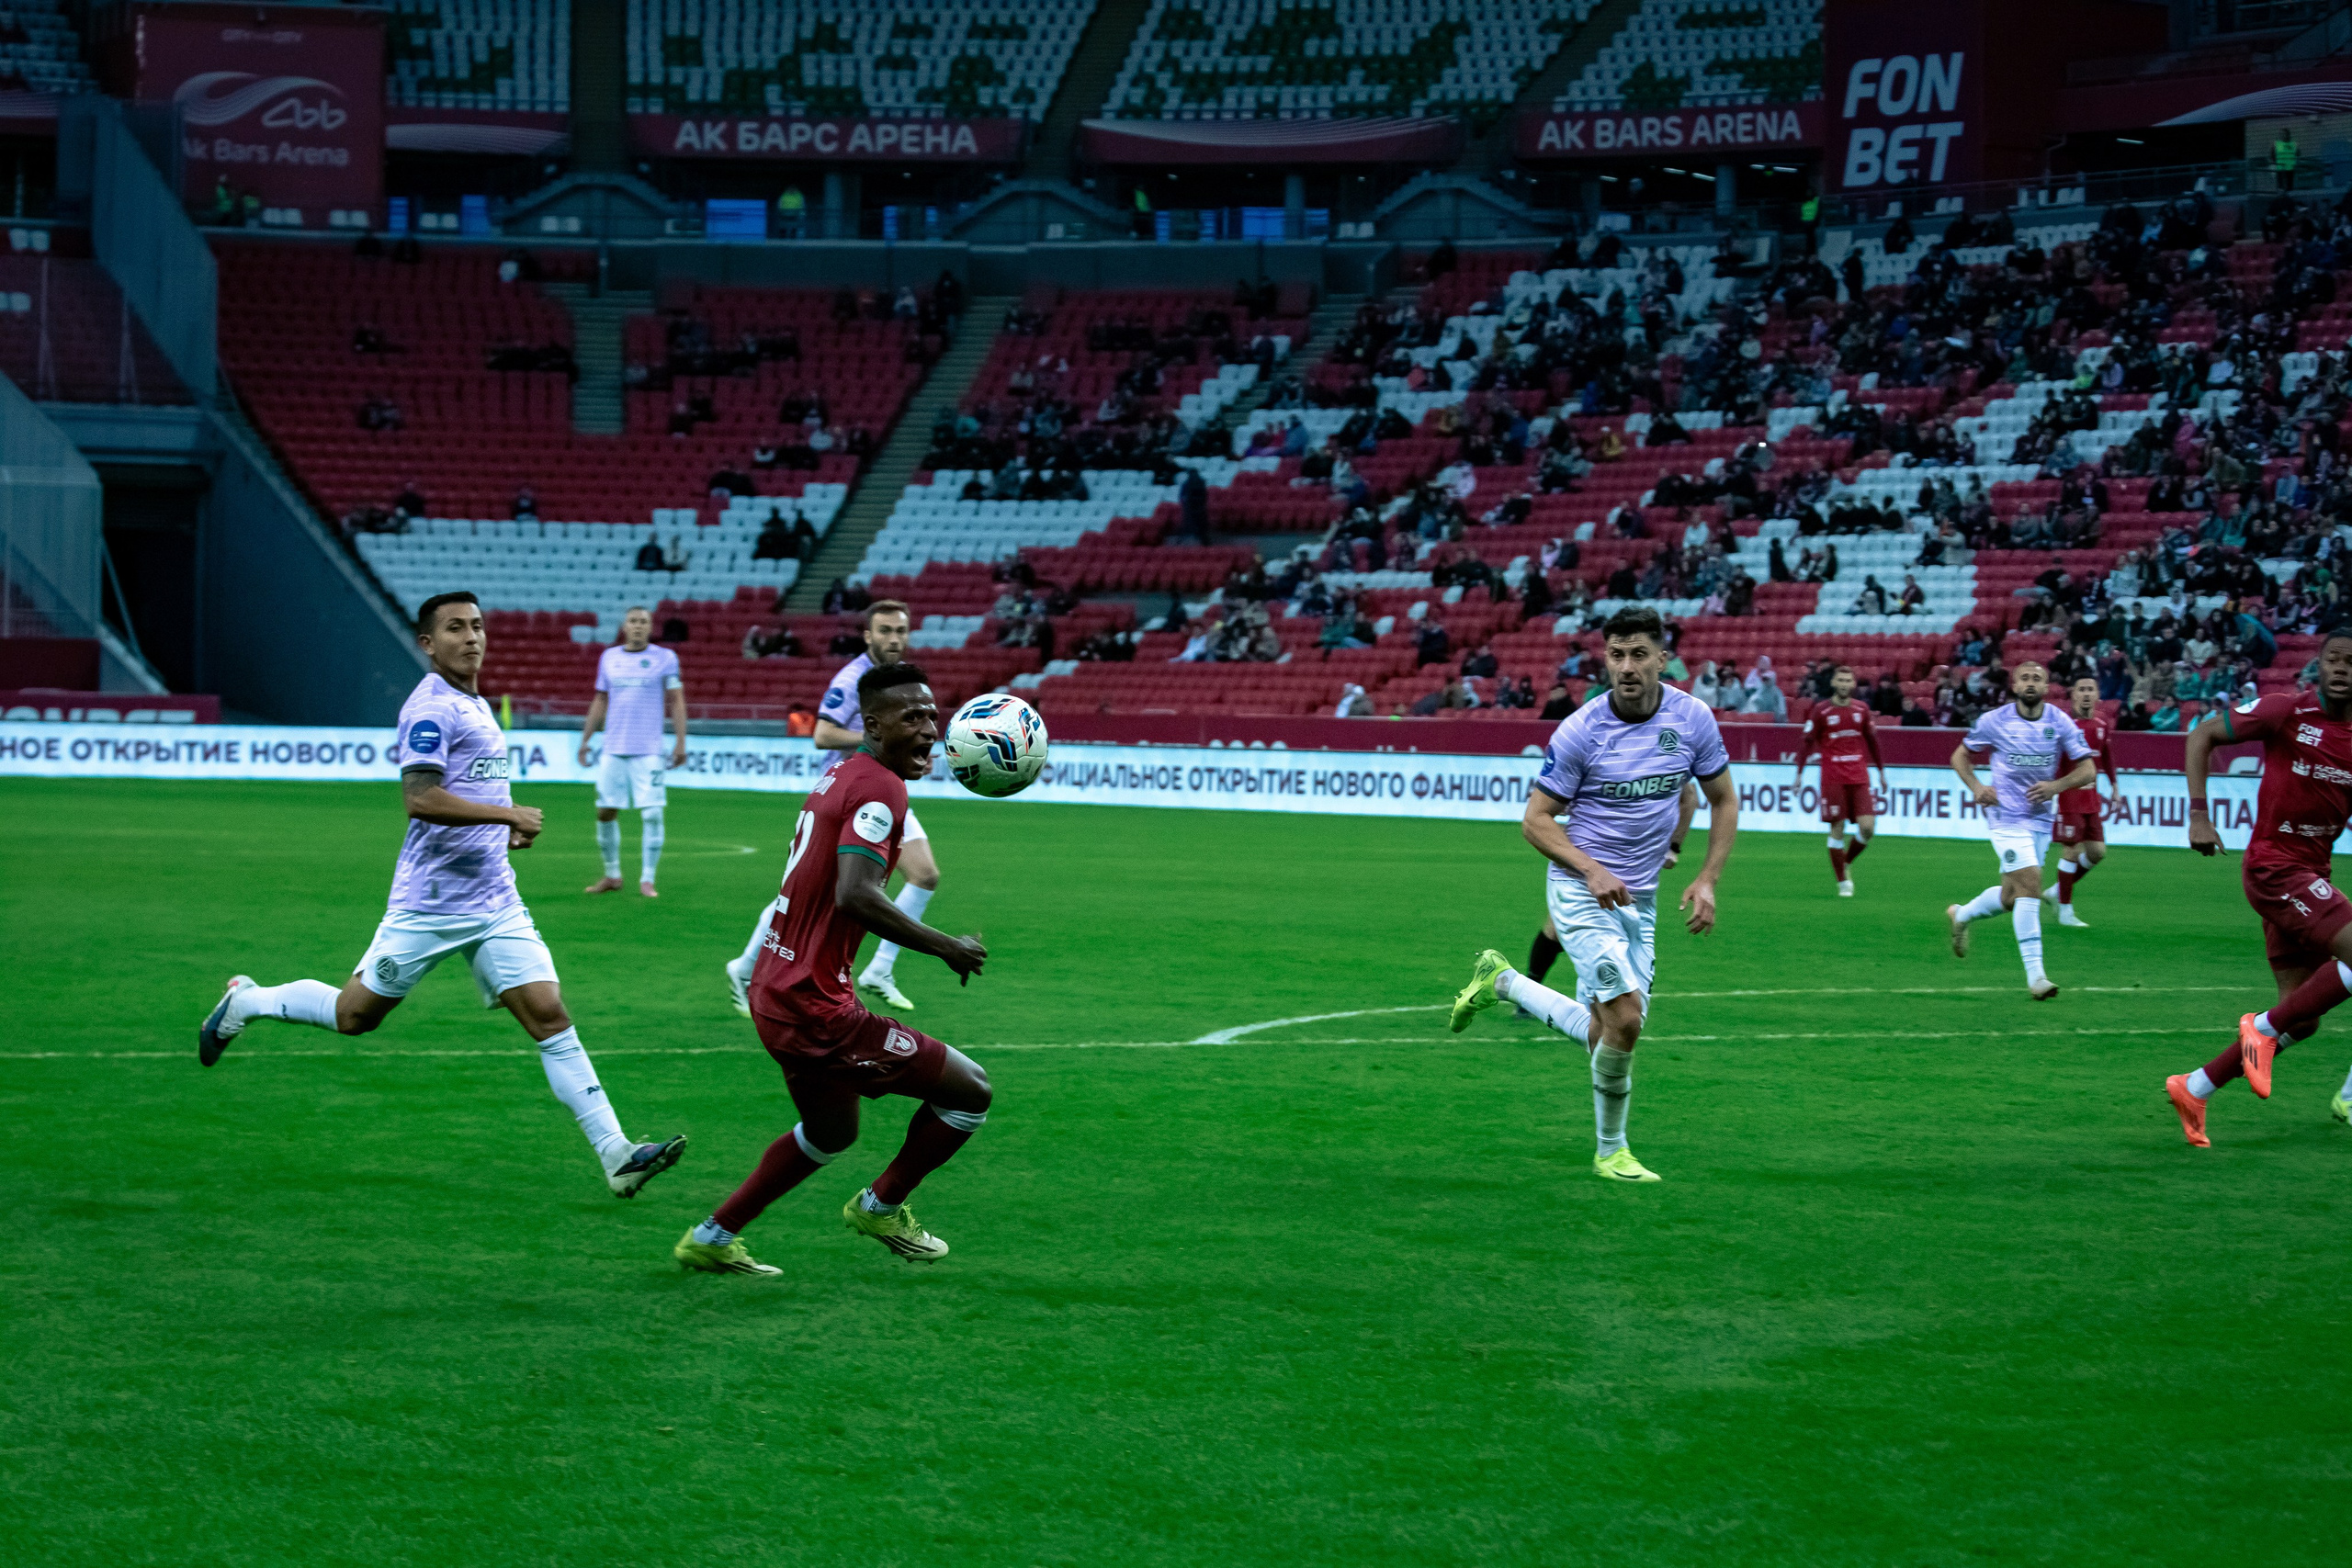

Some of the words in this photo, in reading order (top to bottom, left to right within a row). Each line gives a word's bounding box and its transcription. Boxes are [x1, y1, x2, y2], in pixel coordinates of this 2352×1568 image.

[1841, 51, 1965, 120] FON
[674, 119, 729, 151] АК
[736, 120, 839, 153] БАРС
[846, 123, 978, 154] АРЕНА
[1538, 120, 1586, 151] AK
[1592, 116, 1683, 148] BARS
[1690, 110, 1802, 145] ARENA
[212, 137, 269, 164] Bars
[275, 141, 348, 166] Arena
[1841, 120, 1965, 187] BET
[2295, 732, 2324, 748] BET
[2297, 722, 2324, 738] FON
[70, 738, 240, 763] ОТКРЫТИЕ
[250, 740, 377, 766] НОВОГО
[1188, 765, 1306, 795] ОТКРЫТИЕ
[1312, 772, 1405, 799] НОВОГО
